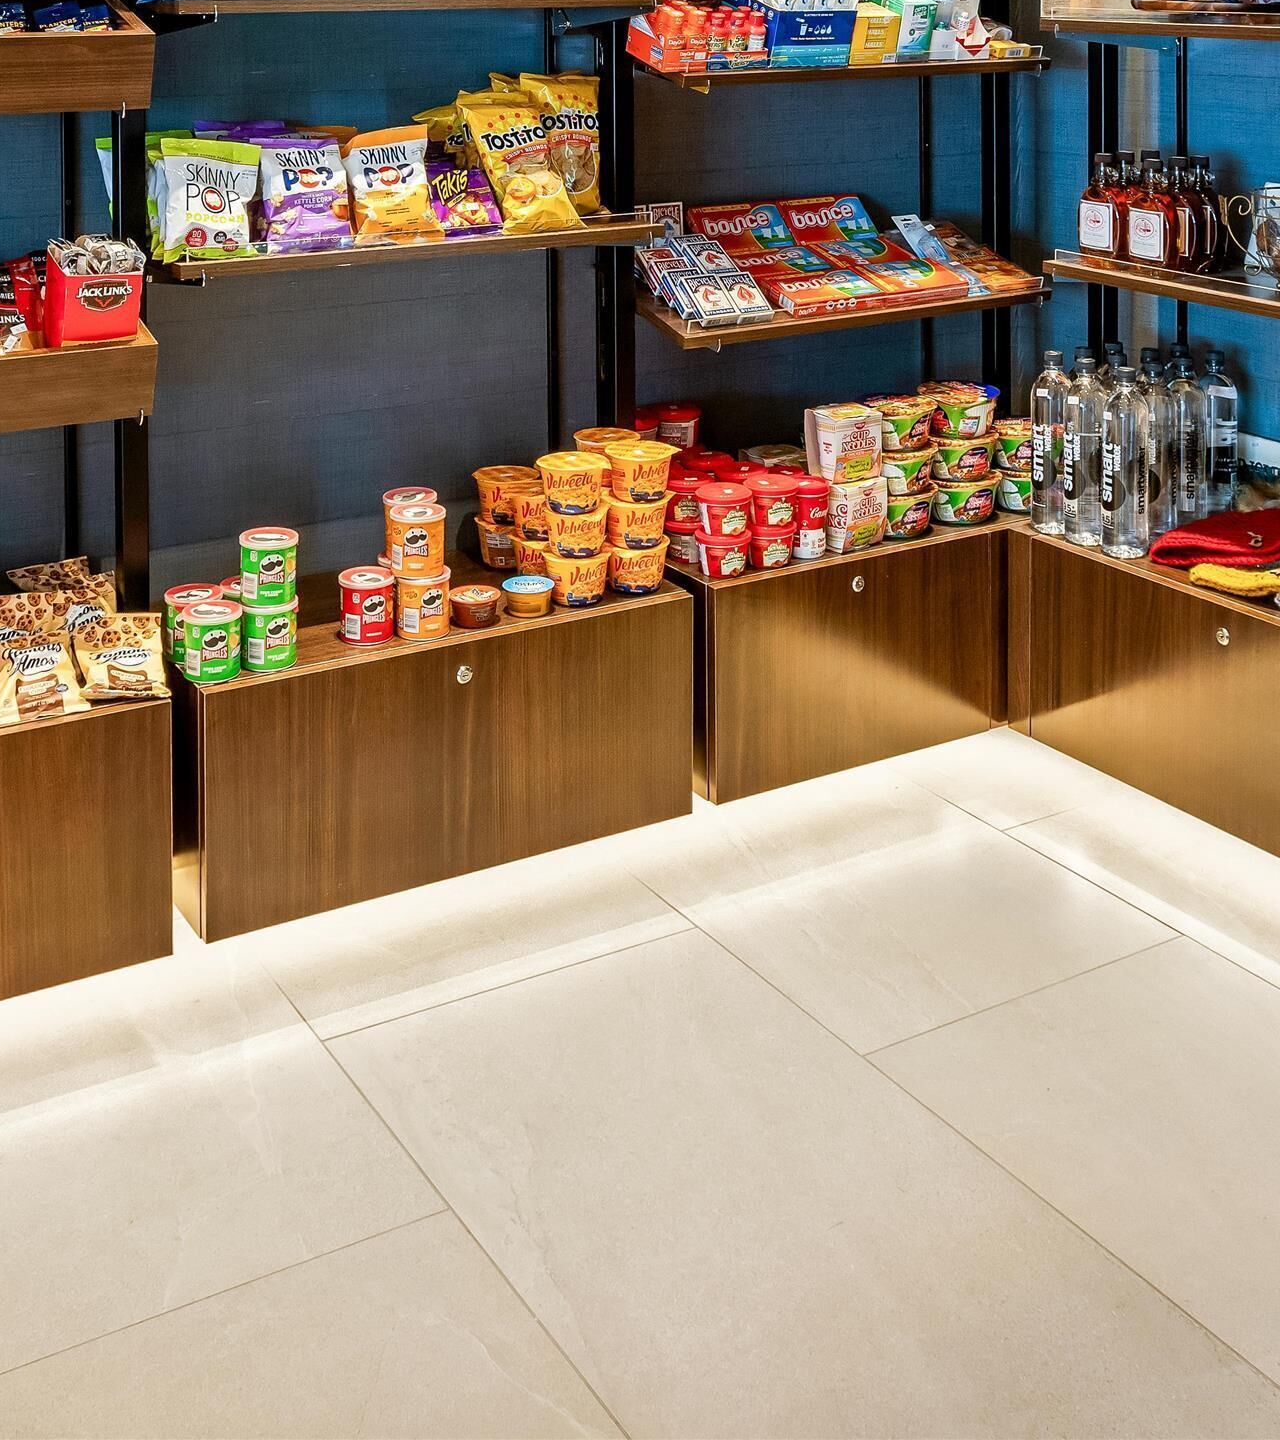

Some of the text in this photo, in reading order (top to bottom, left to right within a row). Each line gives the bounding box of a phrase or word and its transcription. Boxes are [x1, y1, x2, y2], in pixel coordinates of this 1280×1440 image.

[524, 143, 549, 154] ROUNDS
[363, 162, 415, 190] POP
[432, 169, 469, 206] Takis
[185, 182, 242, 215] POP
[294, 195, 333, 206] KETTLE CORN
[184, 212, 246, 225] POPCORN
[703, 210, 770, 236] bounce
[789, 203, 854, 229] bounce
[688, 243, 717, 252] BICYCLE
[737, 244, 803, 268] bounce
[688, 276, 718, 287] BICYCLE
[723, 275, 750, 287] BICYCLE
[781, 269, 849, 293] bounce
[75, 287, 102, 299] JACK
[841, 437, 877, 453] NOODLES
[850, 429, 871, 442] CUP
[1044, 422, 1053, 453] water
[1031, 423, 1046, 483] smart
[1073, 433, 1082, 461] water
[1113, 443, 1122, 472] water
[546, 471, 594, 491] Velveeta
[1101, 440, 1115, 503] smart
[1136, 444, 1147, 516] smartwater
[852, 504, 883, 520] NOODLES
[859, 496, 878, 509] CUP
[613, 553, 662, 573] Velveeta
[260, 572, 286, 585] PRINGLES
[16, 652, 58, 672] Amos
[202, 647, 229, 660] PRINGLES
